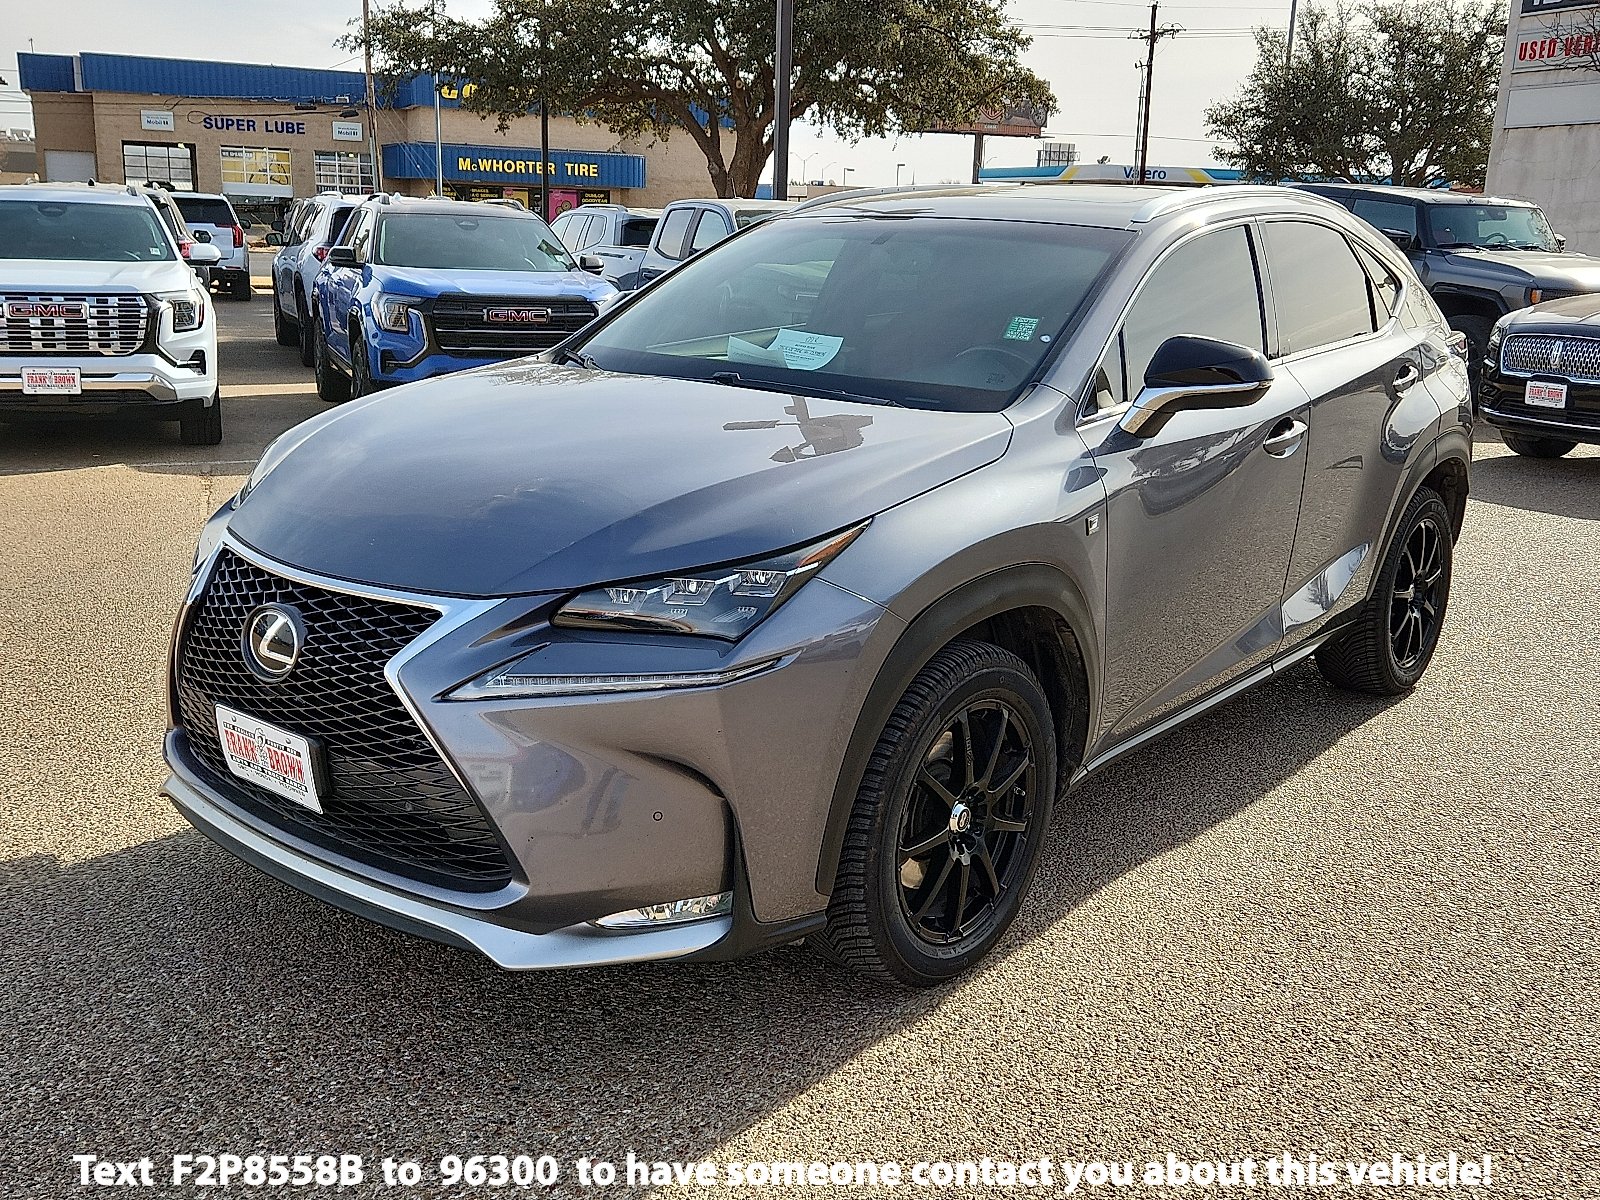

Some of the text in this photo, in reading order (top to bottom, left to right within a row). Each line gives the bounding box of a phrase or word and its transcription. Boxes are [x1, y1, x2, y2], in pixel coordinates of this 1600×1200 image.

[1519, 37, 1557, 61] USED
[203, 116, 306, 135] SUPER LUBE
[458, 157, 598, 177] McWHORTER TIRE
[1123, 166, 1167, 180] Vaero
[10, 303, 83, 318] GMC
[489, 309, 547, 322] GMC
[27, 375, 76, 384] FRANK BROWN
[223, 728, 260, 764] FRANK
[266, 746, 306, 785] BROWN
